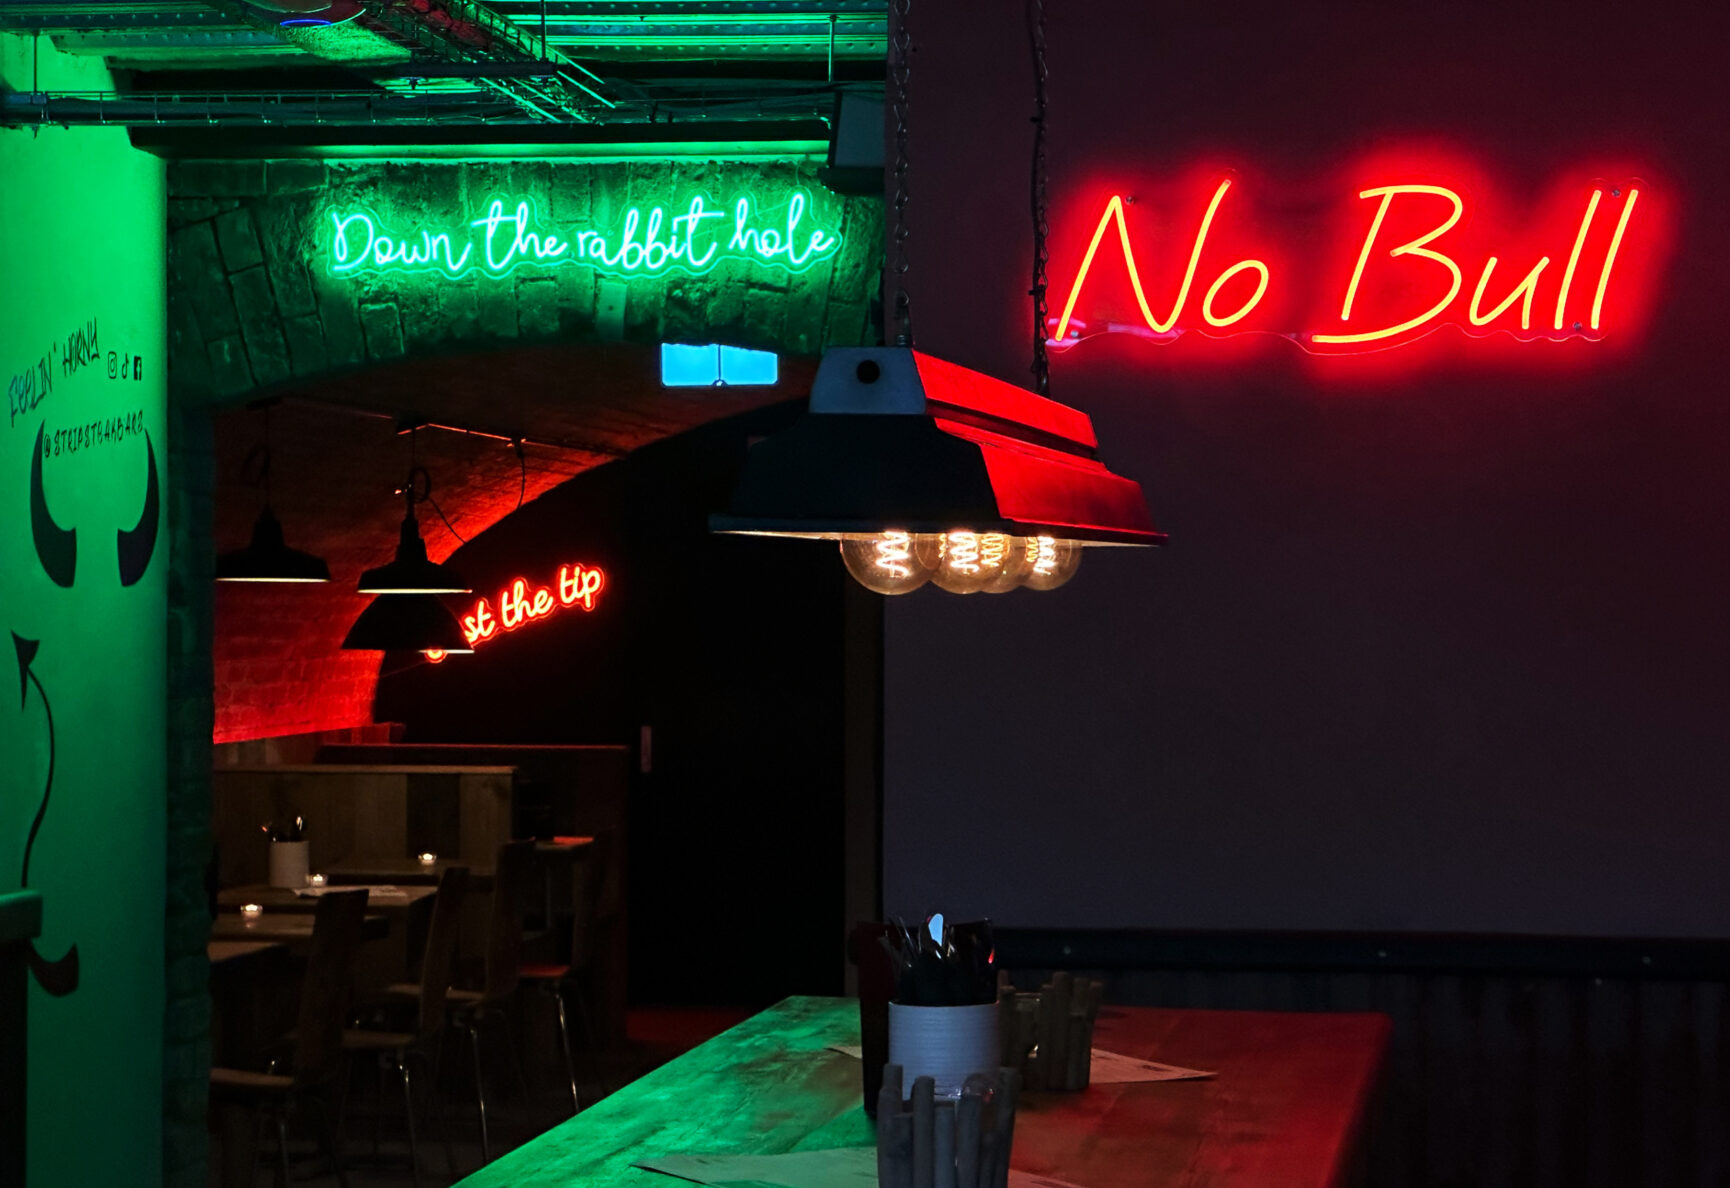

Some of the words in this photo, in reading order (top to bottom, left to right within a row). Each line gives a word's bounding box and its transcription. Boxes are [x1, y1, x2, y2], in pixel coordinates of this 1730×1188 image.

[332, 212, 472, 271] Down
[470, 200, 568, 270] the
[577, 196, 725, 270] rabbit
[728, 193, 835, 265] hole
[1054, 179, 1270, 342] No
[1311, 184, 1639, 344] Bull
[62, 316, 101, 377] HORNY
[501, 578, 554, 628] the
[559, 566, 602, 608] tip
